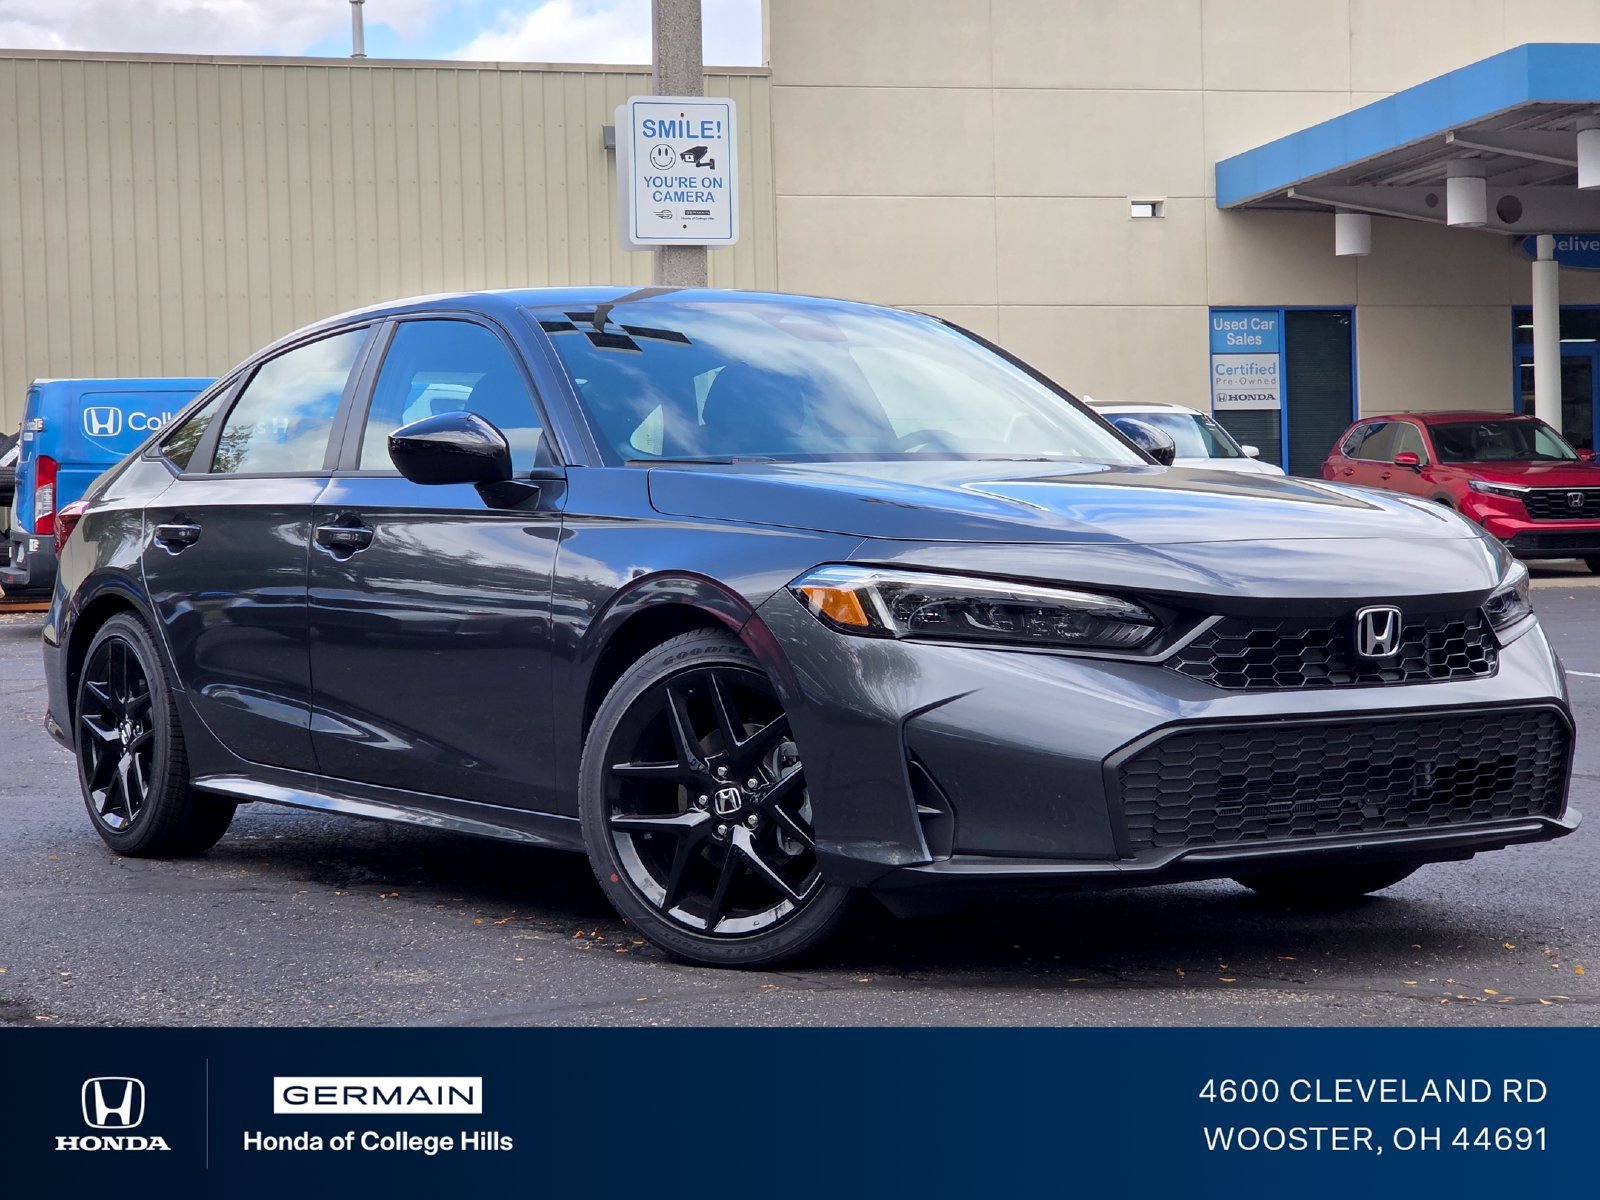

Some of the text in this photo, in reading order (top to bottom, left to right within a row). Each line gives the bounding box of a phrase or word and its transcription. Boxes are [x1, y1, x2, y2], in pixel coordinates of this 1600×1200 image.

[642, 119, 722, 139] SMILE!
[643, 176, 723, 189] YOU'RE ON
[652, 191, 716, 203] CAMERA
[1552, 236, 1600, 251] elive
[1213, 318, 1275, 330] Used Car
[1226, 333, 1263, 346] Sales
[1215, 362, 1277, 376] Certified
[1215, 377, 1277, 386] Pre-Owned
